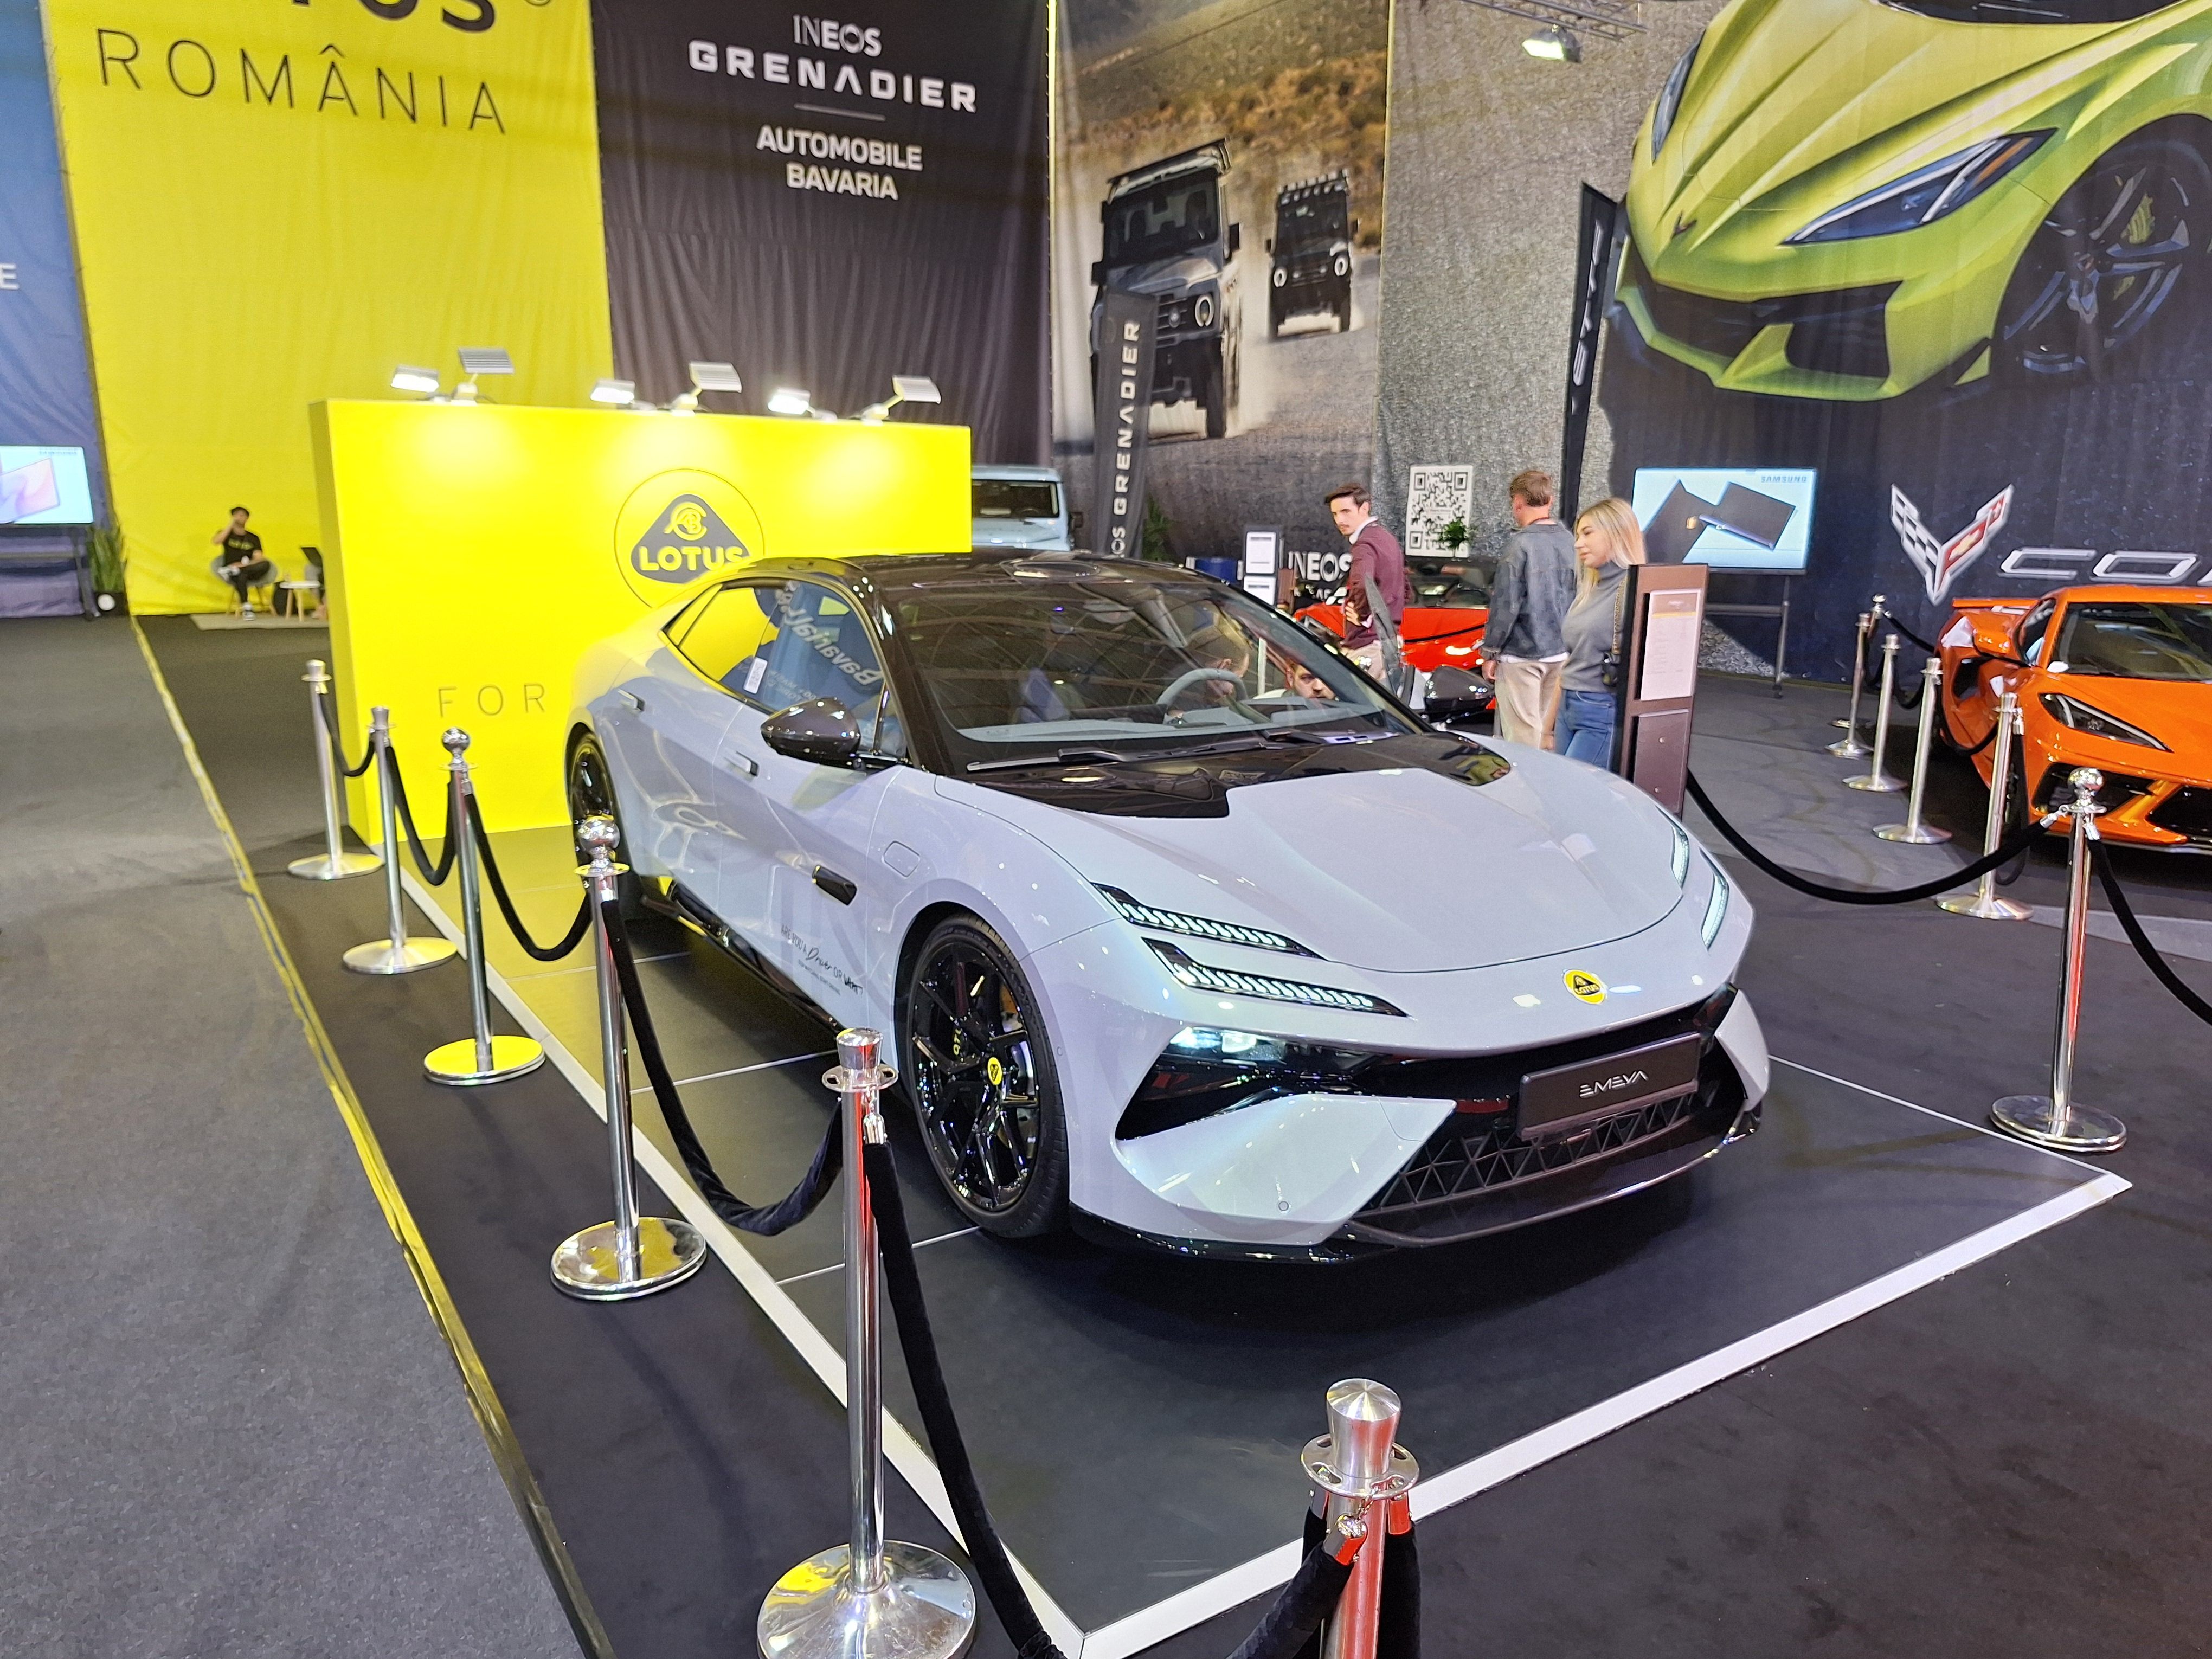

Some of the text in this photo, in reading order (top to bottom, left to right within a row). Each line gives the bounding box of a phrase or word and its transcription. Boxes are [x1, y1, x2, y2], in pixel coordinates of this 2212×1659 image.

[793, 15, 882, 57] INEOS
[97, 28, 505, 134] ROMÂNIA
[688, 39, 976, 113] GRENADIER
[756, 124, 923, 171] AUTOMOBILE
[786, 161, 898, 200] BAVARIA
[1111, 321, 1140, 558] OS GRENADIER
[639, 546, 743, 571] LOTUS
[1997, 546, 2212, 587] CO
[438, 684, 545, 718] FOR
